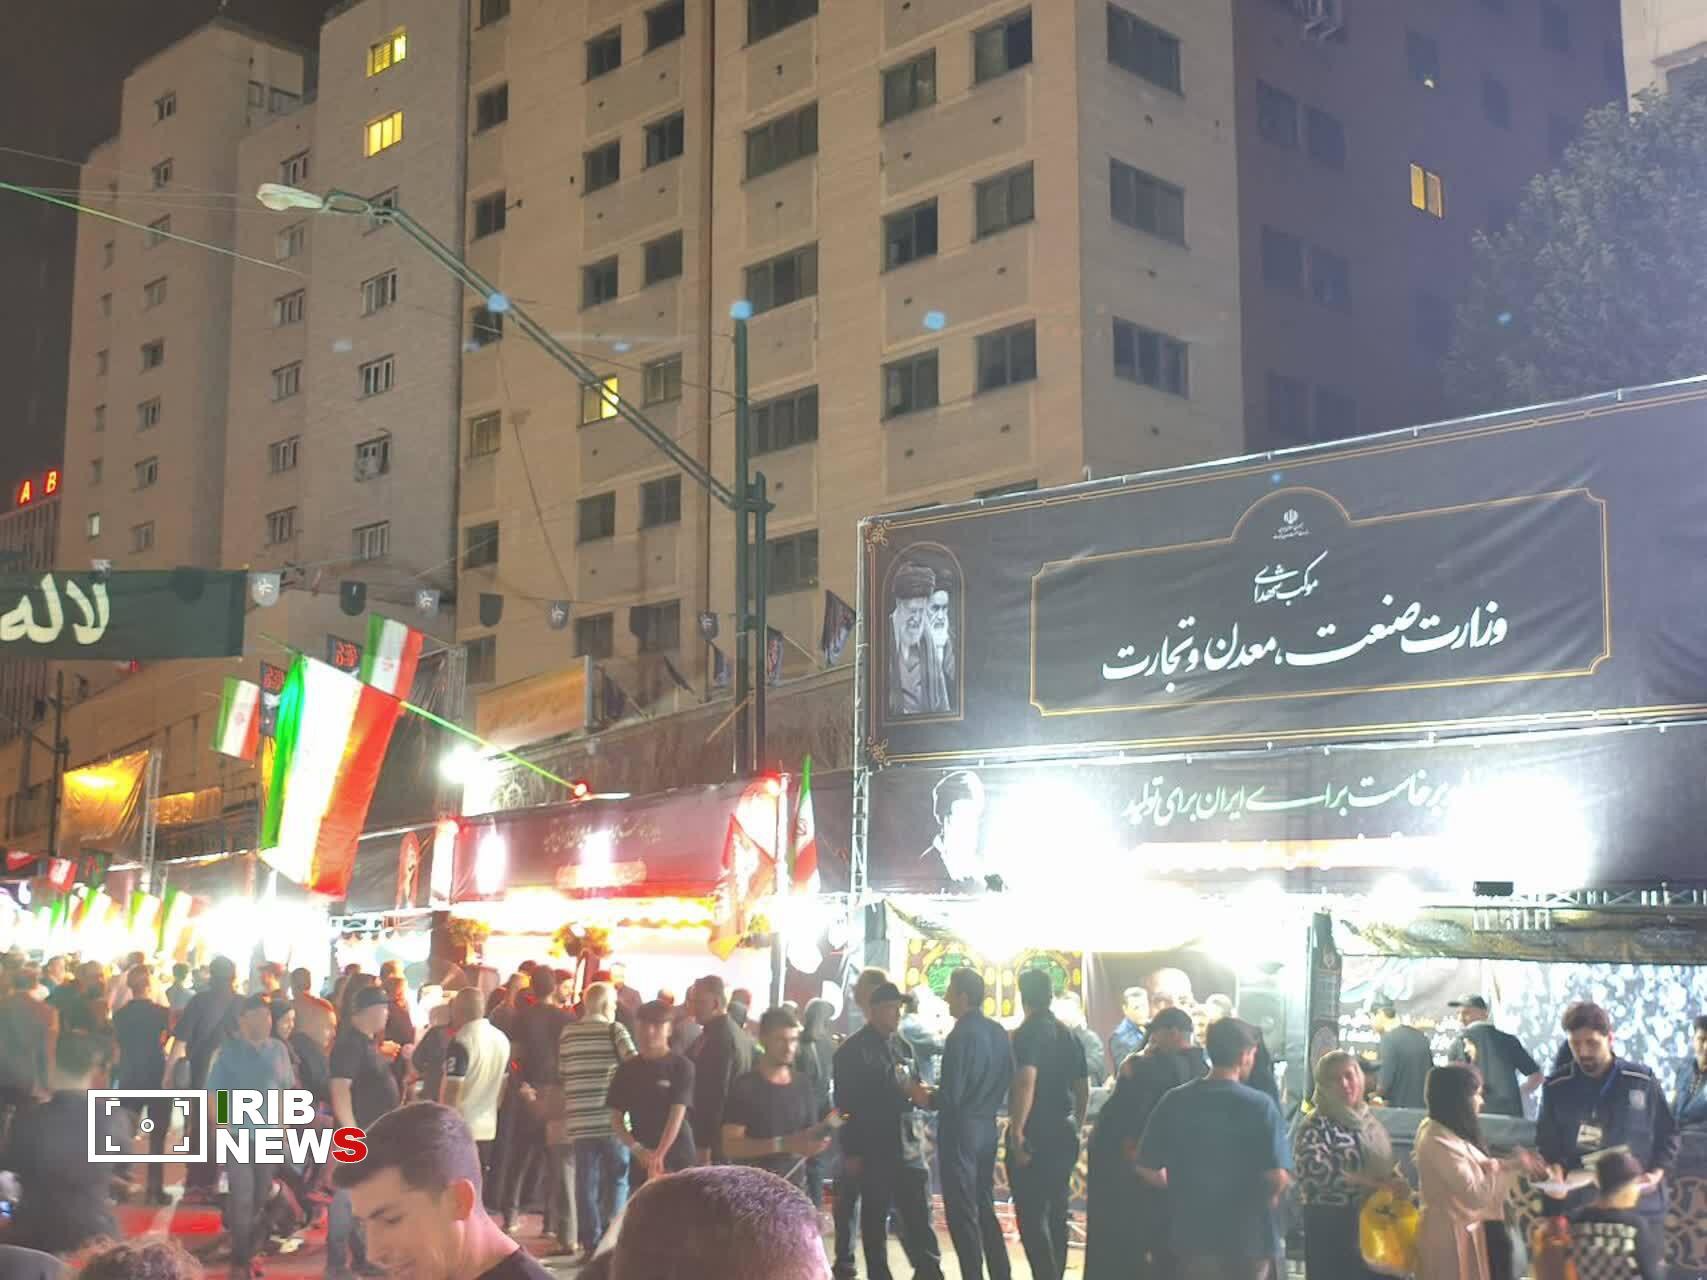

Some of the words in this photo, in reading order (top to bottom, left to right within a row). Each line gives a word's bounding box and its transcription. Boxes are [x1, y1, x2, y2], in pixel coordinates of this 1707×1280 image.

[1203, 621, 1277, 672] معدن
[1400, 600, 1508, 654] وزارت
[1102, 615, 1196, 694] تجارت
